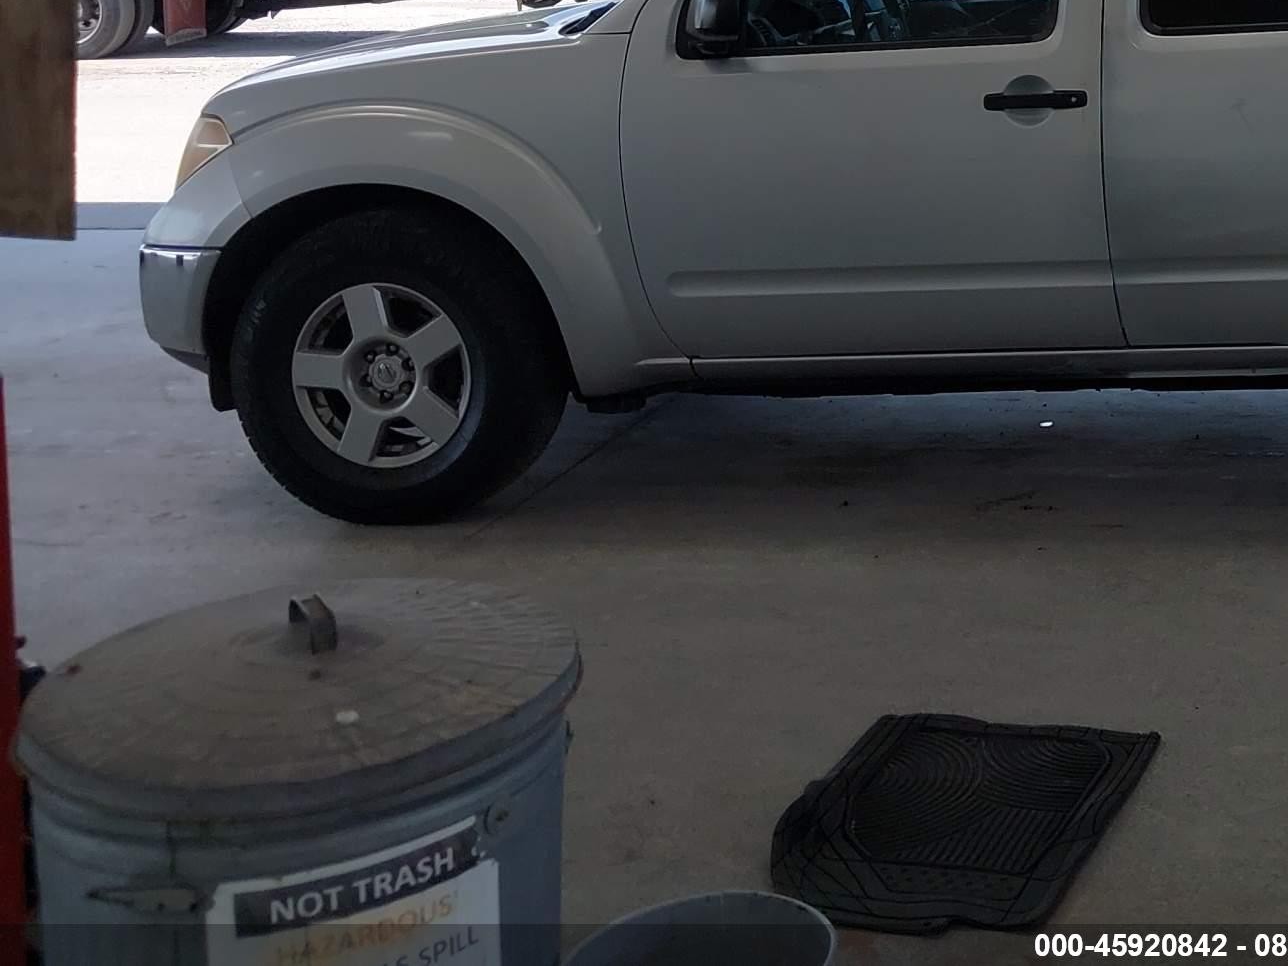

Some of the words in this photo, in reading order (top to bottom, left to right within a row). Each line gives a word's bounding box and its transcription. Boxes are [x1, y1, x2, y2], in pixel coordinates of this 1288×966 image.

[270, 886, 344, 924] NOT
[352, 846, 455, 904] TRASH
[277, 893, 456, 966] HAZARDOUS
[418, 925, 479, 966] SPILL
